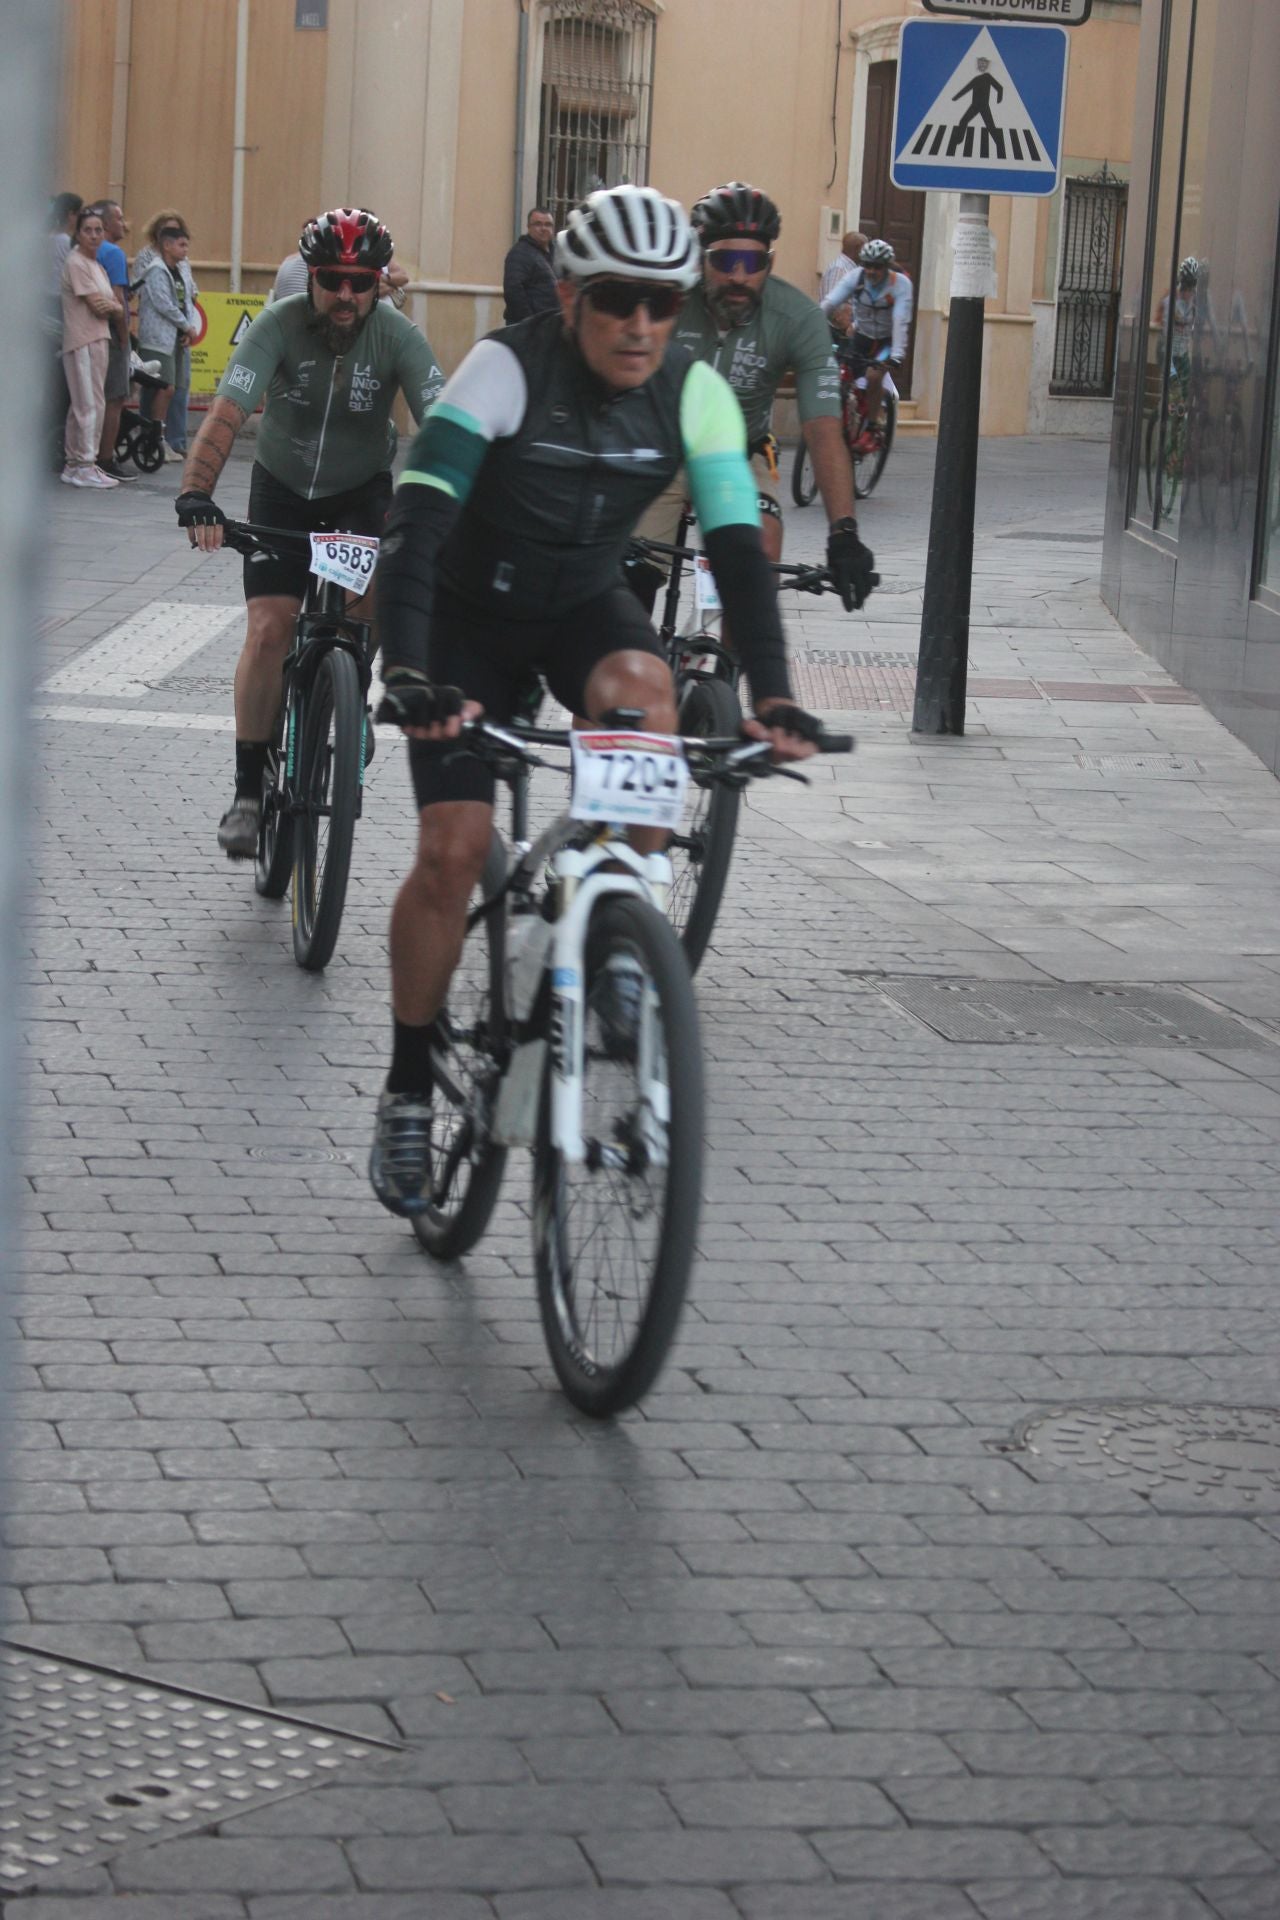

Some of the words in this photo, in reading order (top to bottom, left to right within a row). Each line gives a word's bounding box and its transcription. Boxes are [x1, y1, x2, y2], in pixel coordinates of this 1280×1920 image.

[944, 0, 1071, 13] DUMBRE
[326, 542, 374, 574] 6583
[600, 754, 678, 793] 7204
